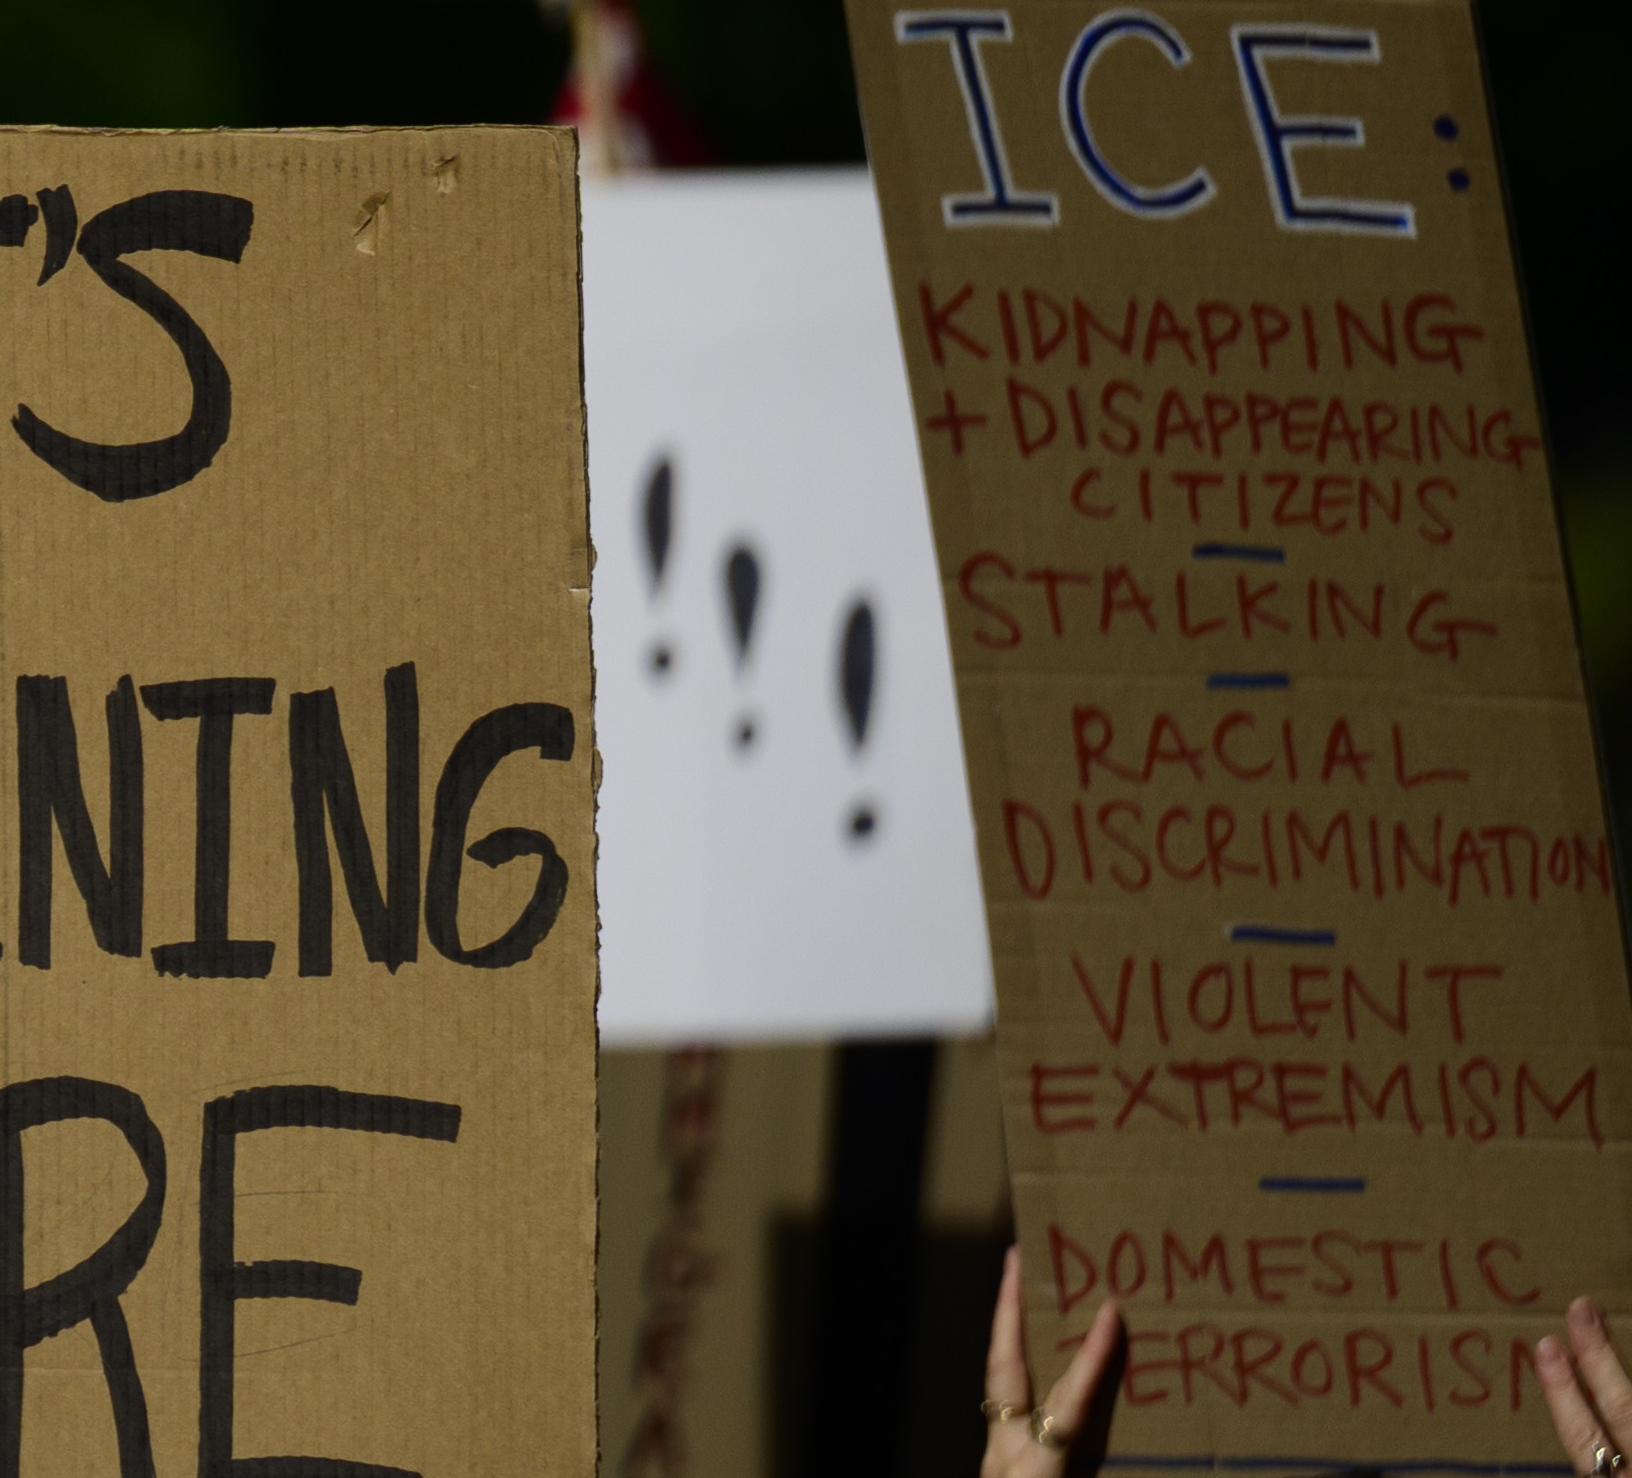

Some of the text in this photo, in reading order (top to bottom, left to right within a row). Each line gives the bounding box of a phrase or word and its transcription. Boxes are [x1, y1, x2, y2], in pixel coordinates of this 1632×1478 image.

[919, 283, 1483, 373] KIDNAPPING
[1007, 377, 1542, 475] DISAPPEARING
[1070, 469, 1458, 546] CITIZENS
[958, 552, 1498, 659] STALKING
[1073, 706, 1469, 788] RACIAL
[1003, 800, 1611, 905] DISCRIMINATION
[1071, 952, 1503, 1044] VIOLENT
[1030, 1058, 1605, 1149] EXTREMISM
[1048, 1225, 1542, 1315] DOMESTIC
